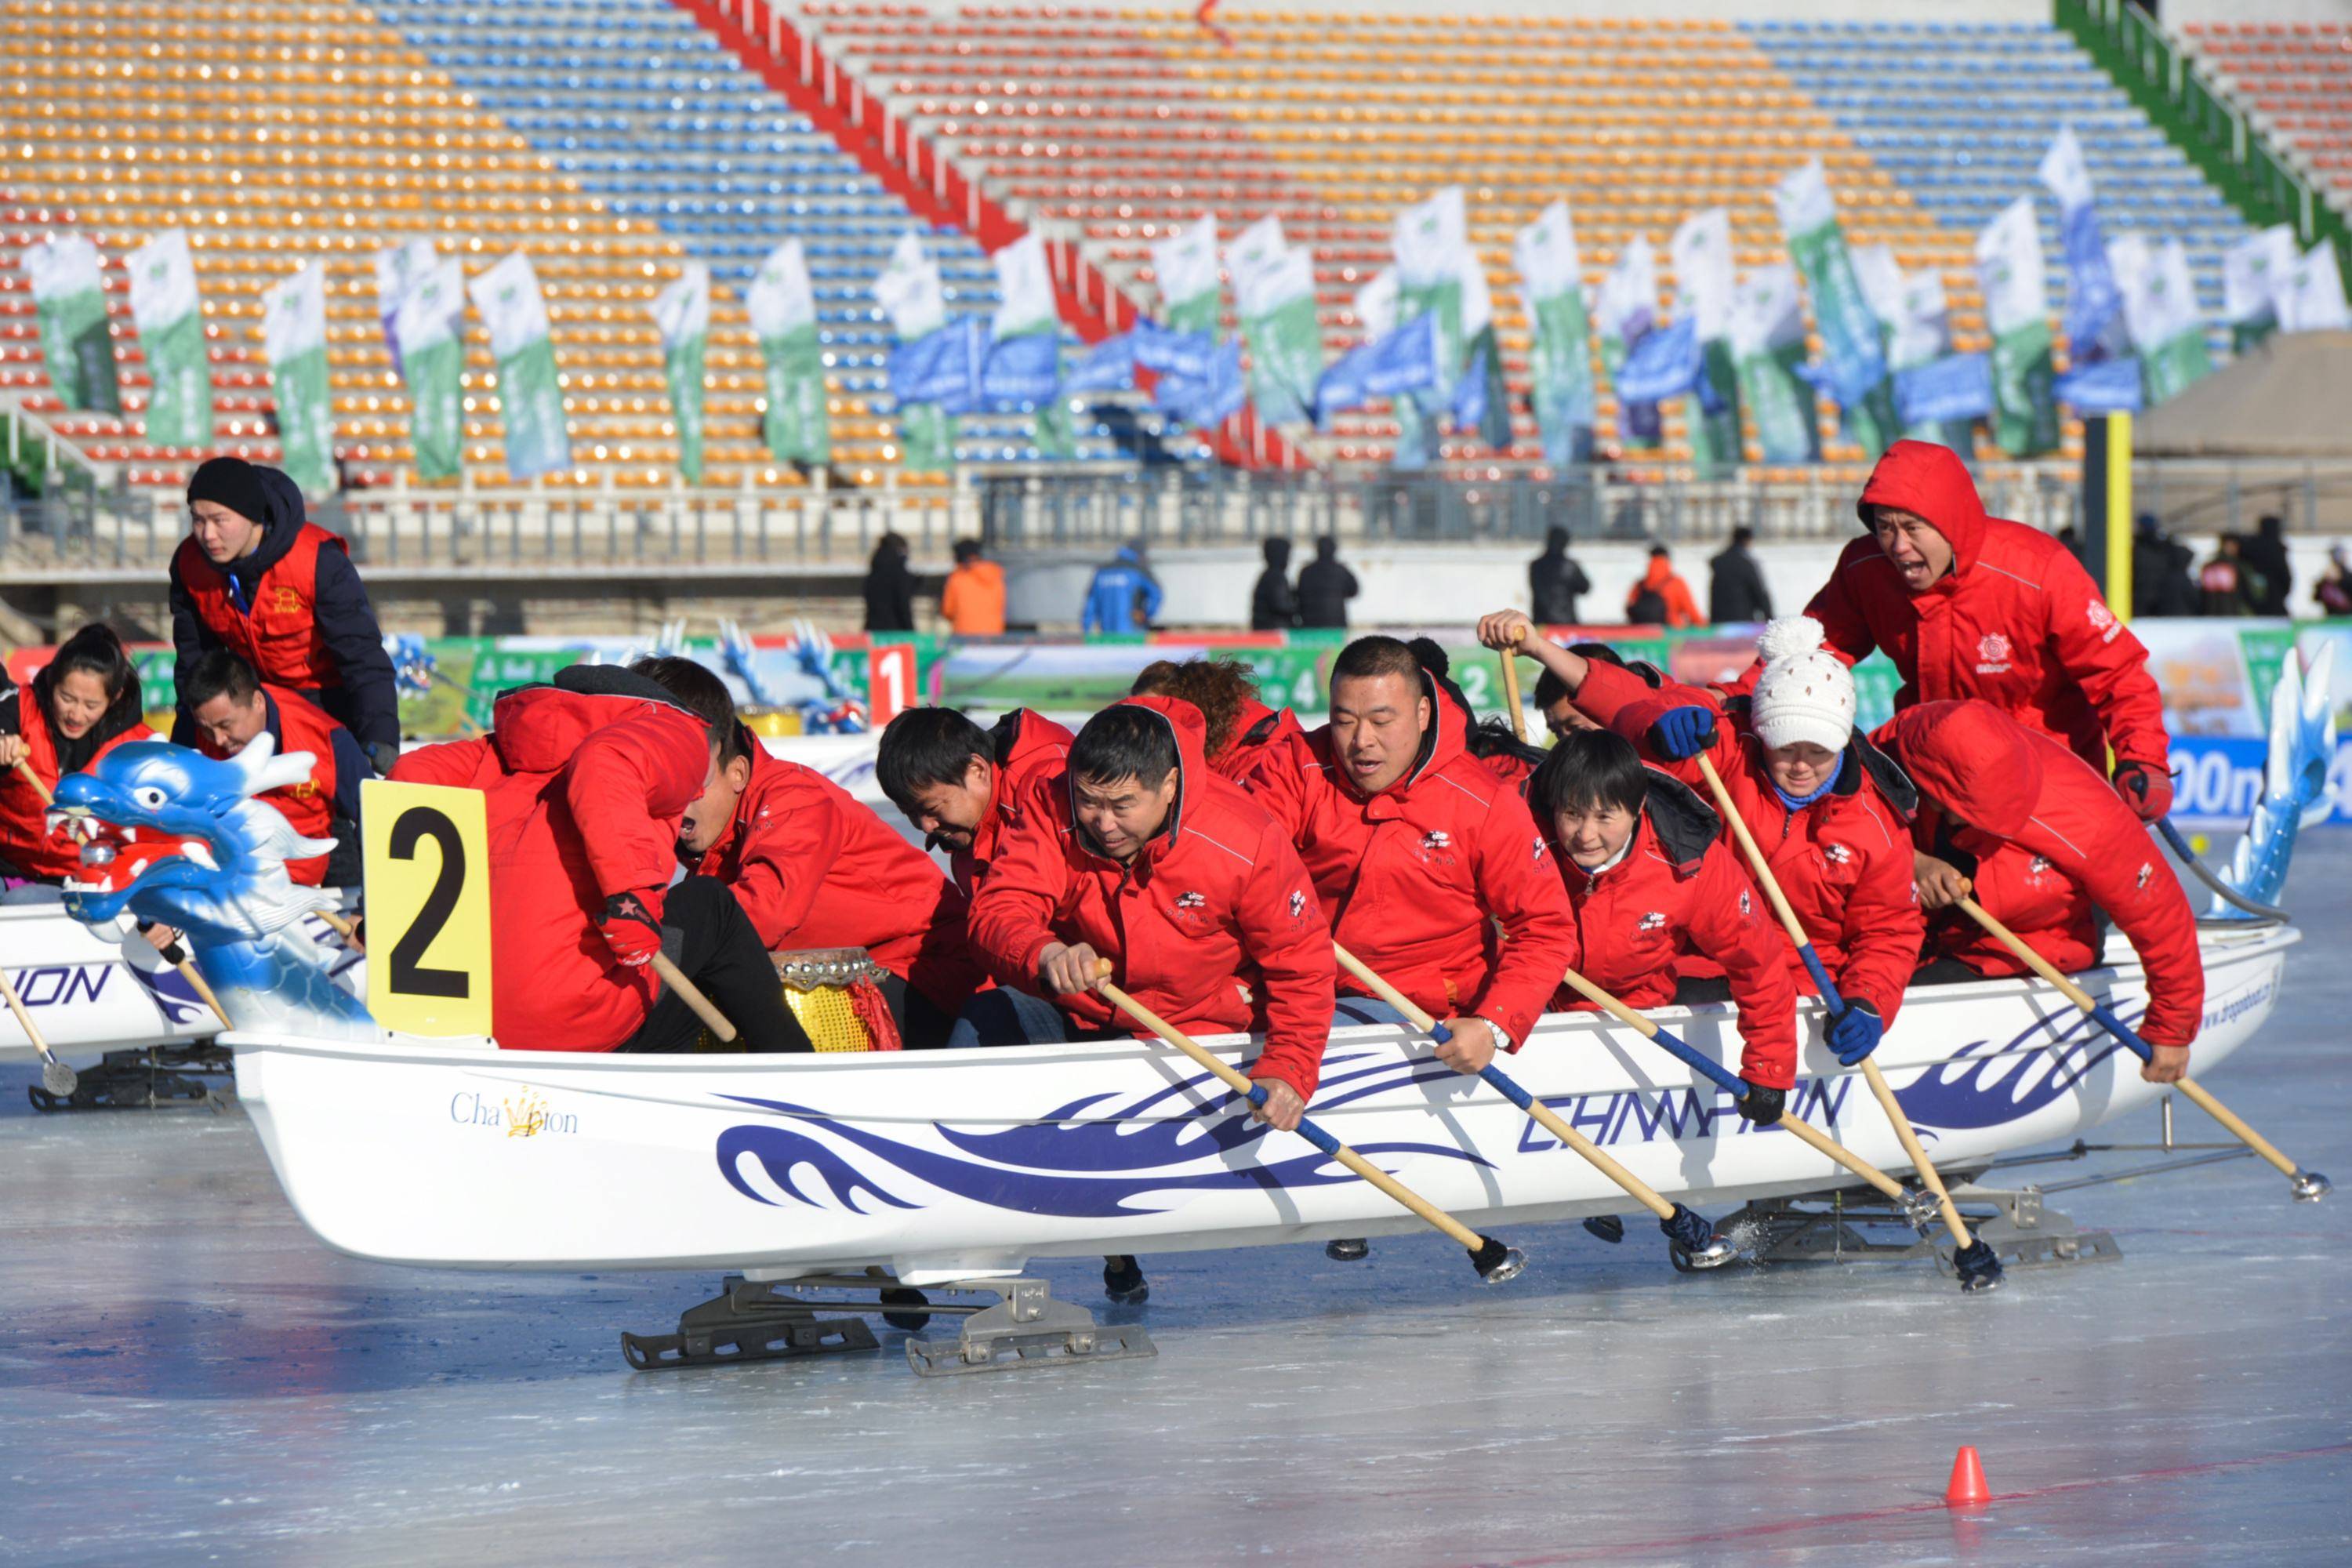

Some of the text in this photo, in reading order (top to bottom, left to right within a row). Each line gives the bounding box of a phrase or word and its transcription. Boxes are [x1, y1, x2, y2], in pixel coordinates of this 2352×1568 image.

[880, 651, 903, 715] 1
[1463, 666, 1489, 704] 2
[389, 806, 469, 998] 2
[451, 1091, 578, 1138] Chapion
